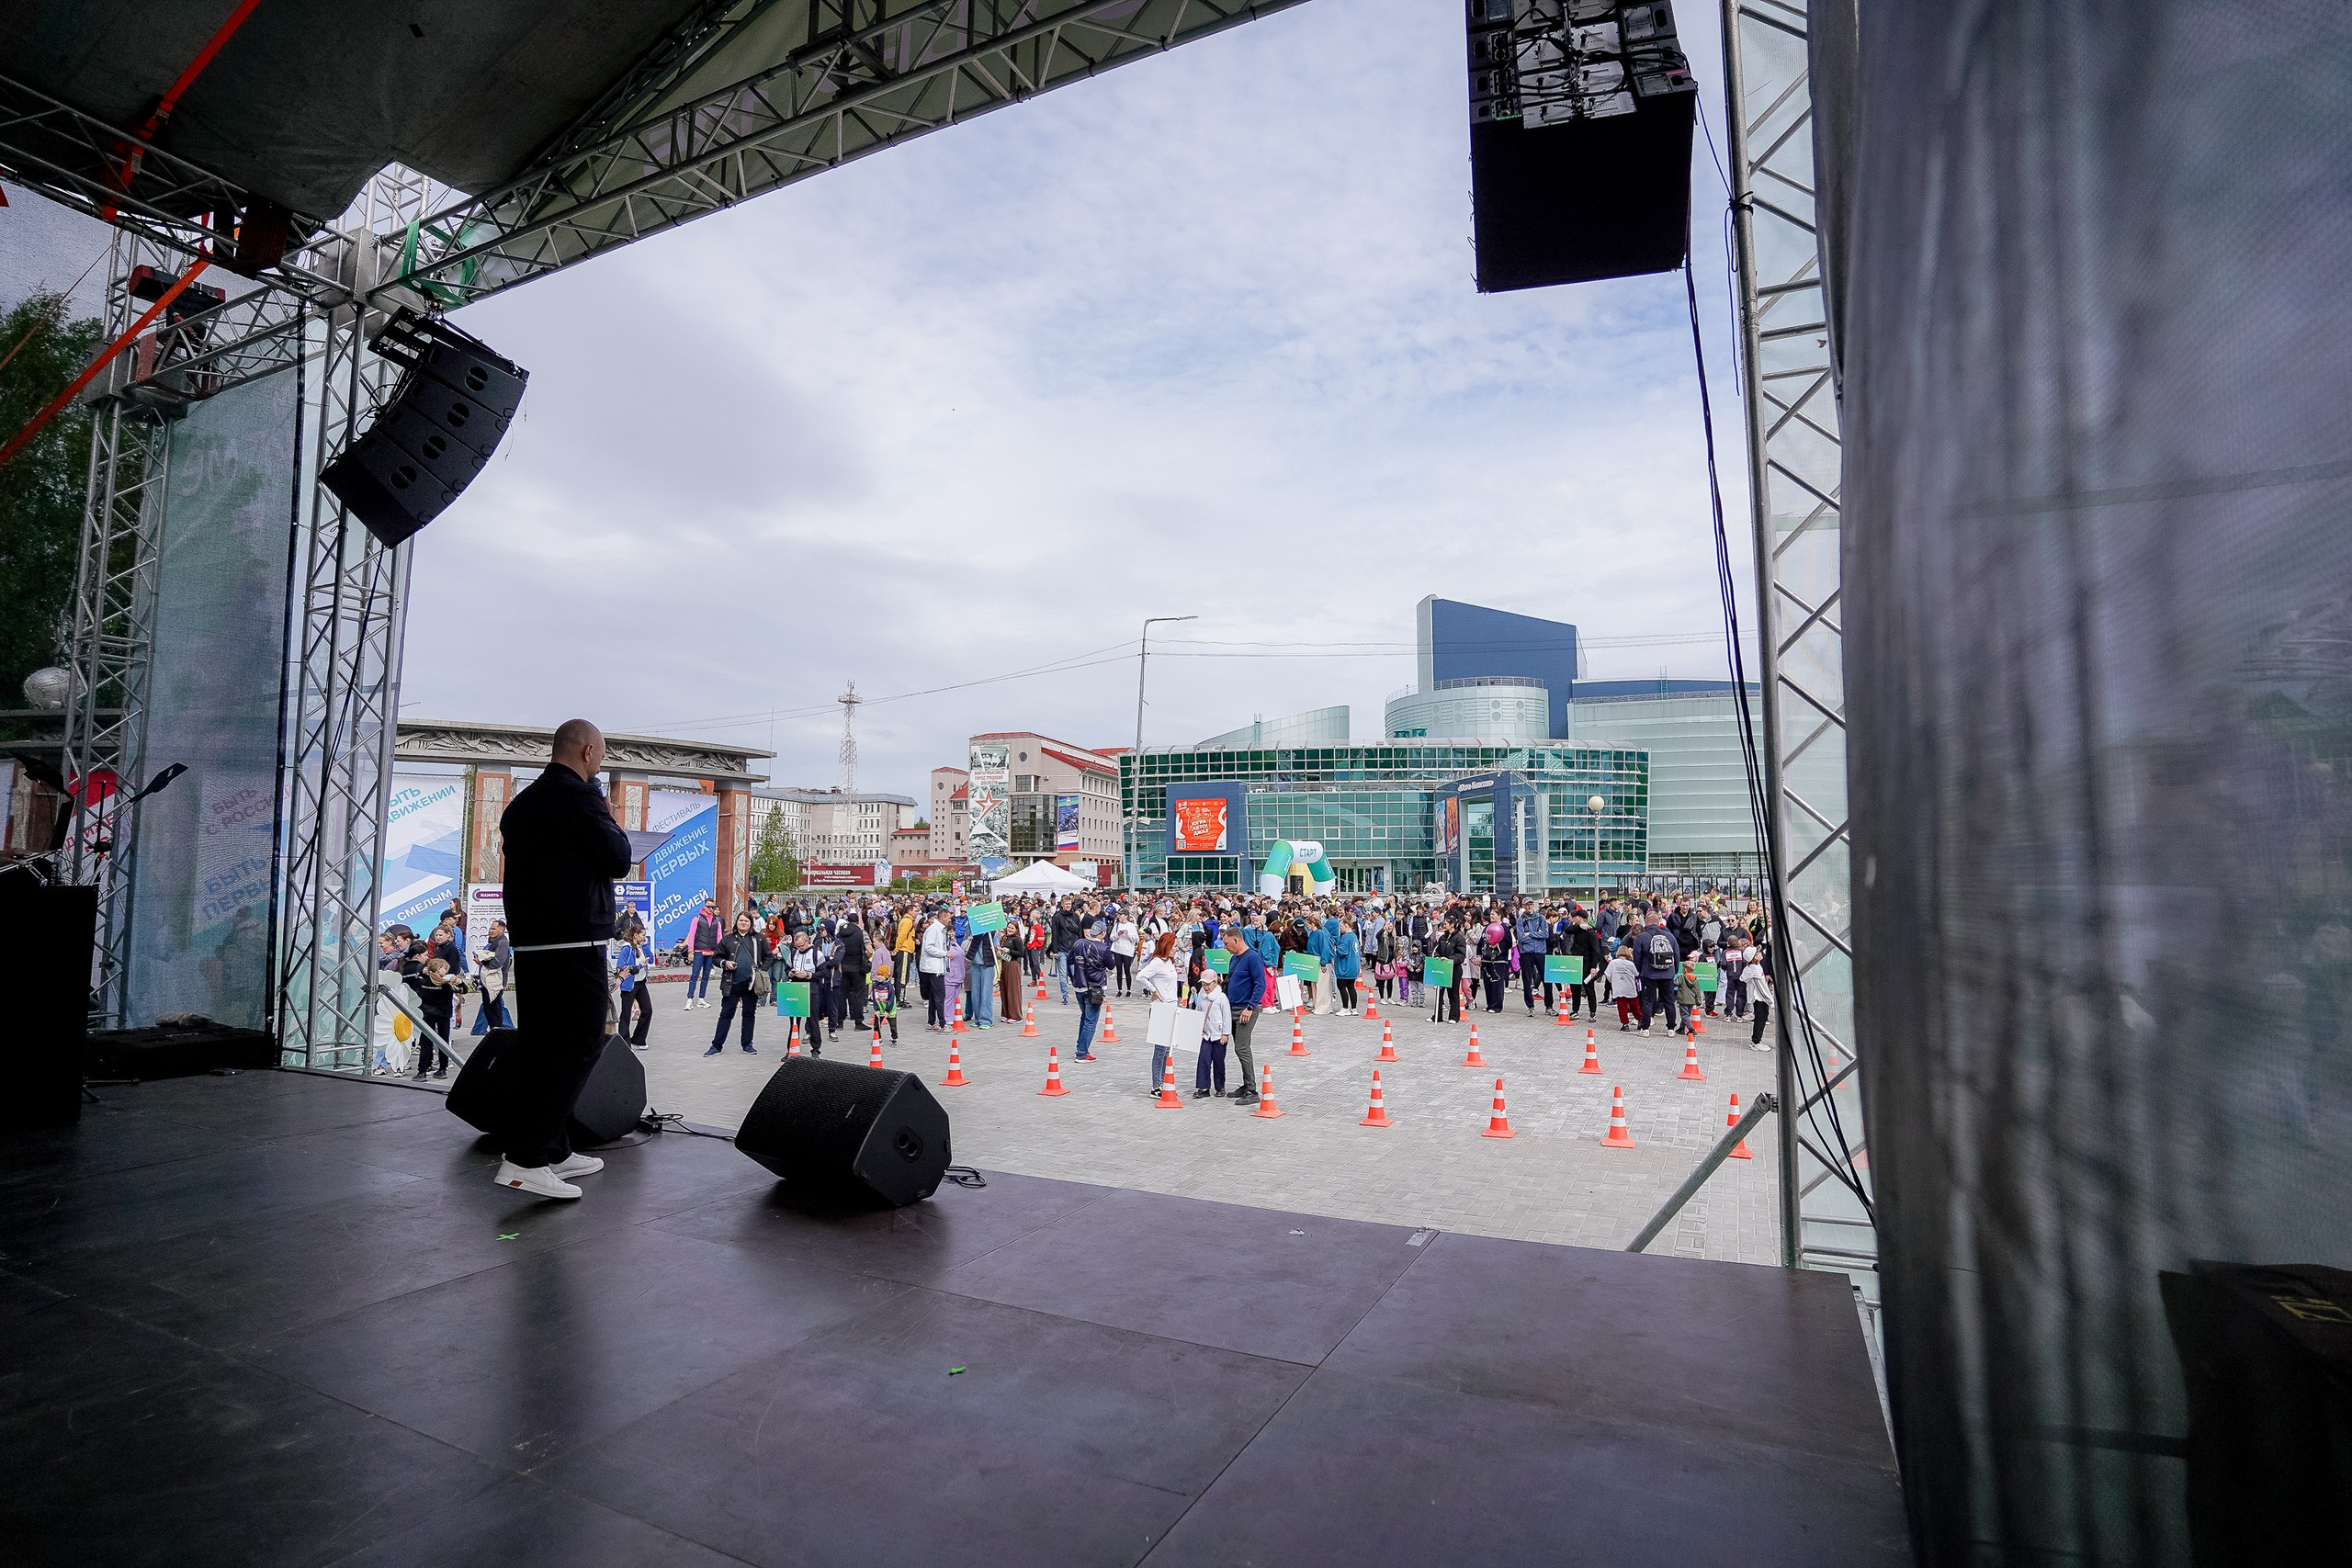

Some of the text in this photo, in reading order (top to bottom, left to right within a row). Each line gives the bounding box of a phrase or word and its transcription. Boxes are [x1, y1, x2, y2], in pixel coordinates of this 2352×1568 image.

[389, 788, 422, 808] ЫТЬ
[652, 802, 701, 832] ФЕСТИВАЛЬ
[654, 825, 709, 865] ДВИЖЕНИЕ
[1299, 848, 1317, 858] СТАРТ
[650, 840, 710, 884] ПЕРВЫХ
[397, 888, 453, 921] СМЕЛЫМ
[657, 888, 709, 930] РОССИЕЙ
